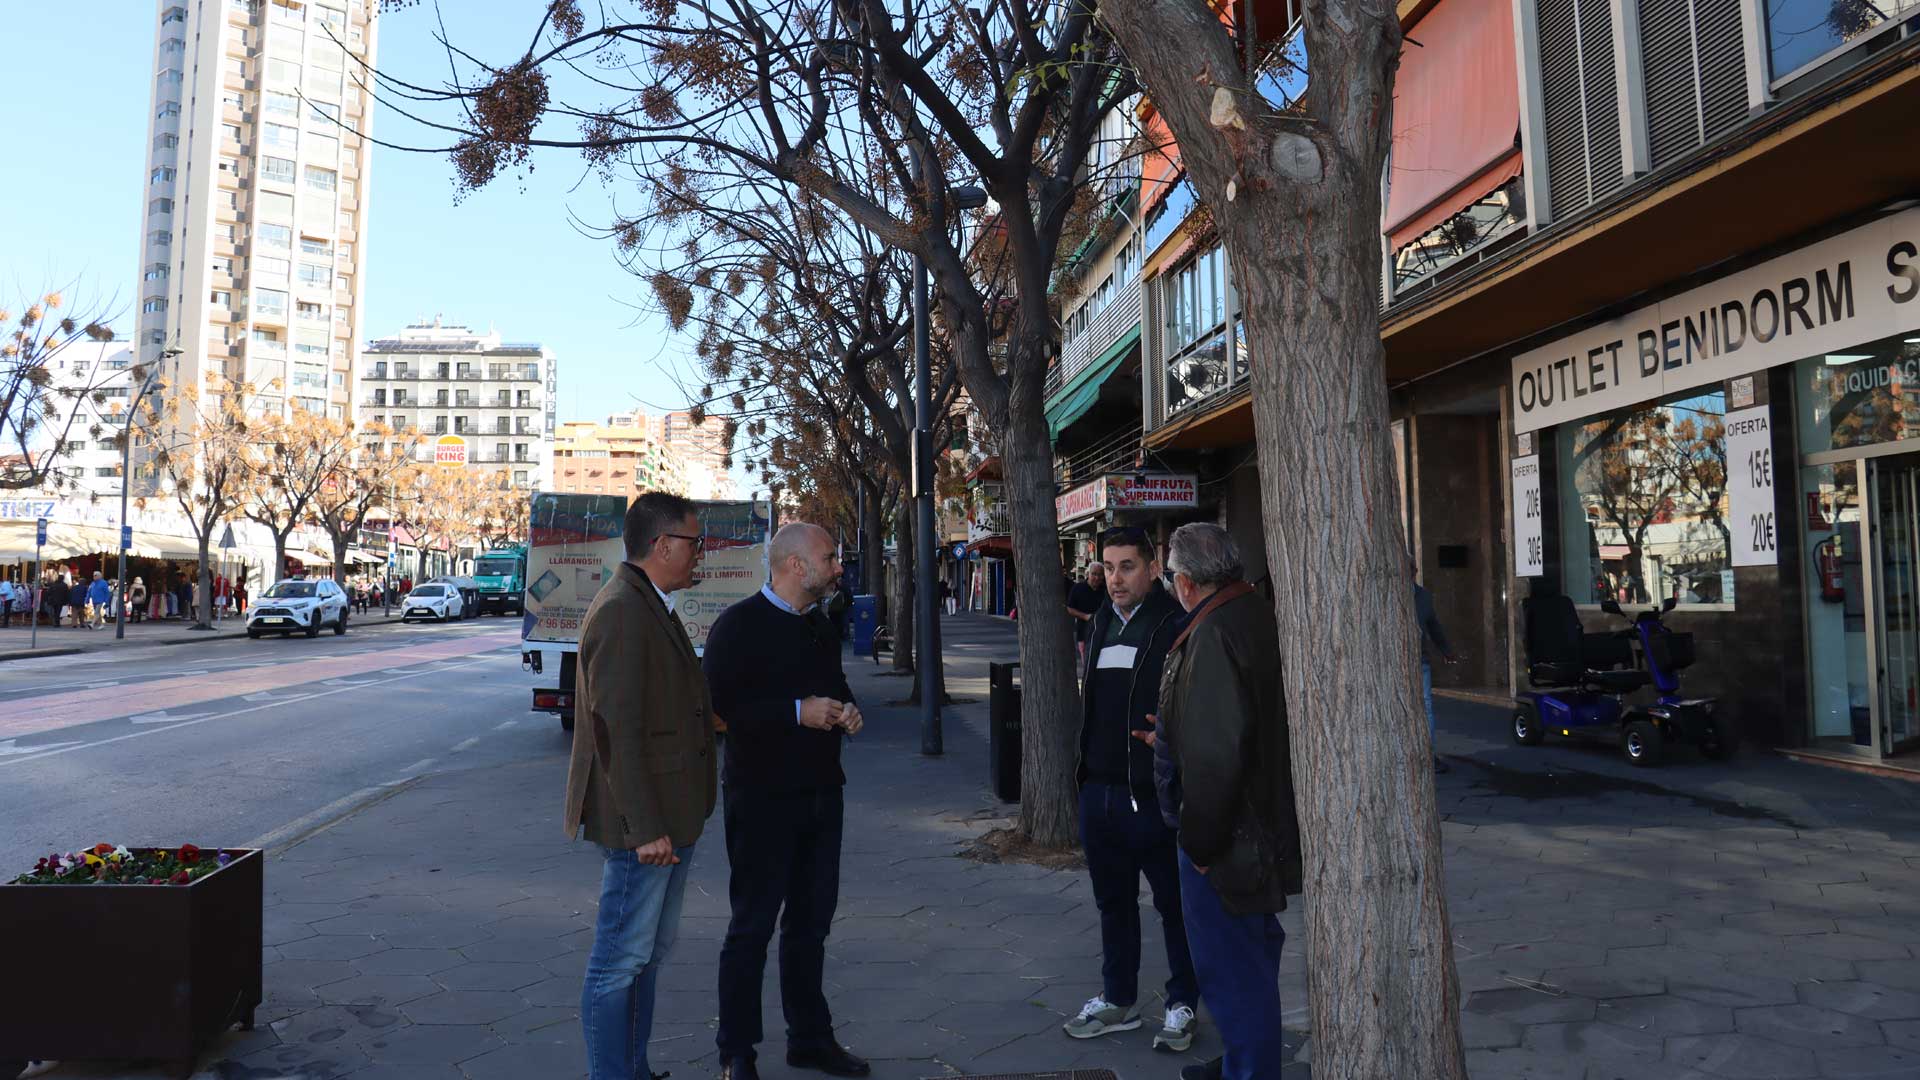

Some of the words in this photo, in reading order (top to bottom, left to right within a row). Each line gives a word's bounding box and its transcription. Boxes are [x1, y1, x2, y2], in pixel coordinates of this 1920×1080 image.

[1518, 339, 1624, 413] OUTLET
[1637, 260, 1856, 379] BENIDORM
[545, 359, 557, 413] JAIME
[1834, 357, 1920, 398] LIQUIDAC
[1727, 417, 1768, 437] OFERTA
[436, 452, 465, 461] KING
[1513, 463, 1538, 478] OFERTA
[1748, 447, 1771, 489] 15€
[1124, 491, 1194, 502] SUPERMARKET
[1525, 487, 1540, 519] 20€
[1751, 511, 1775, 552] 20€
[1527, 535, 1542, 567] 30€
[546, 617, 558, 629] 96
